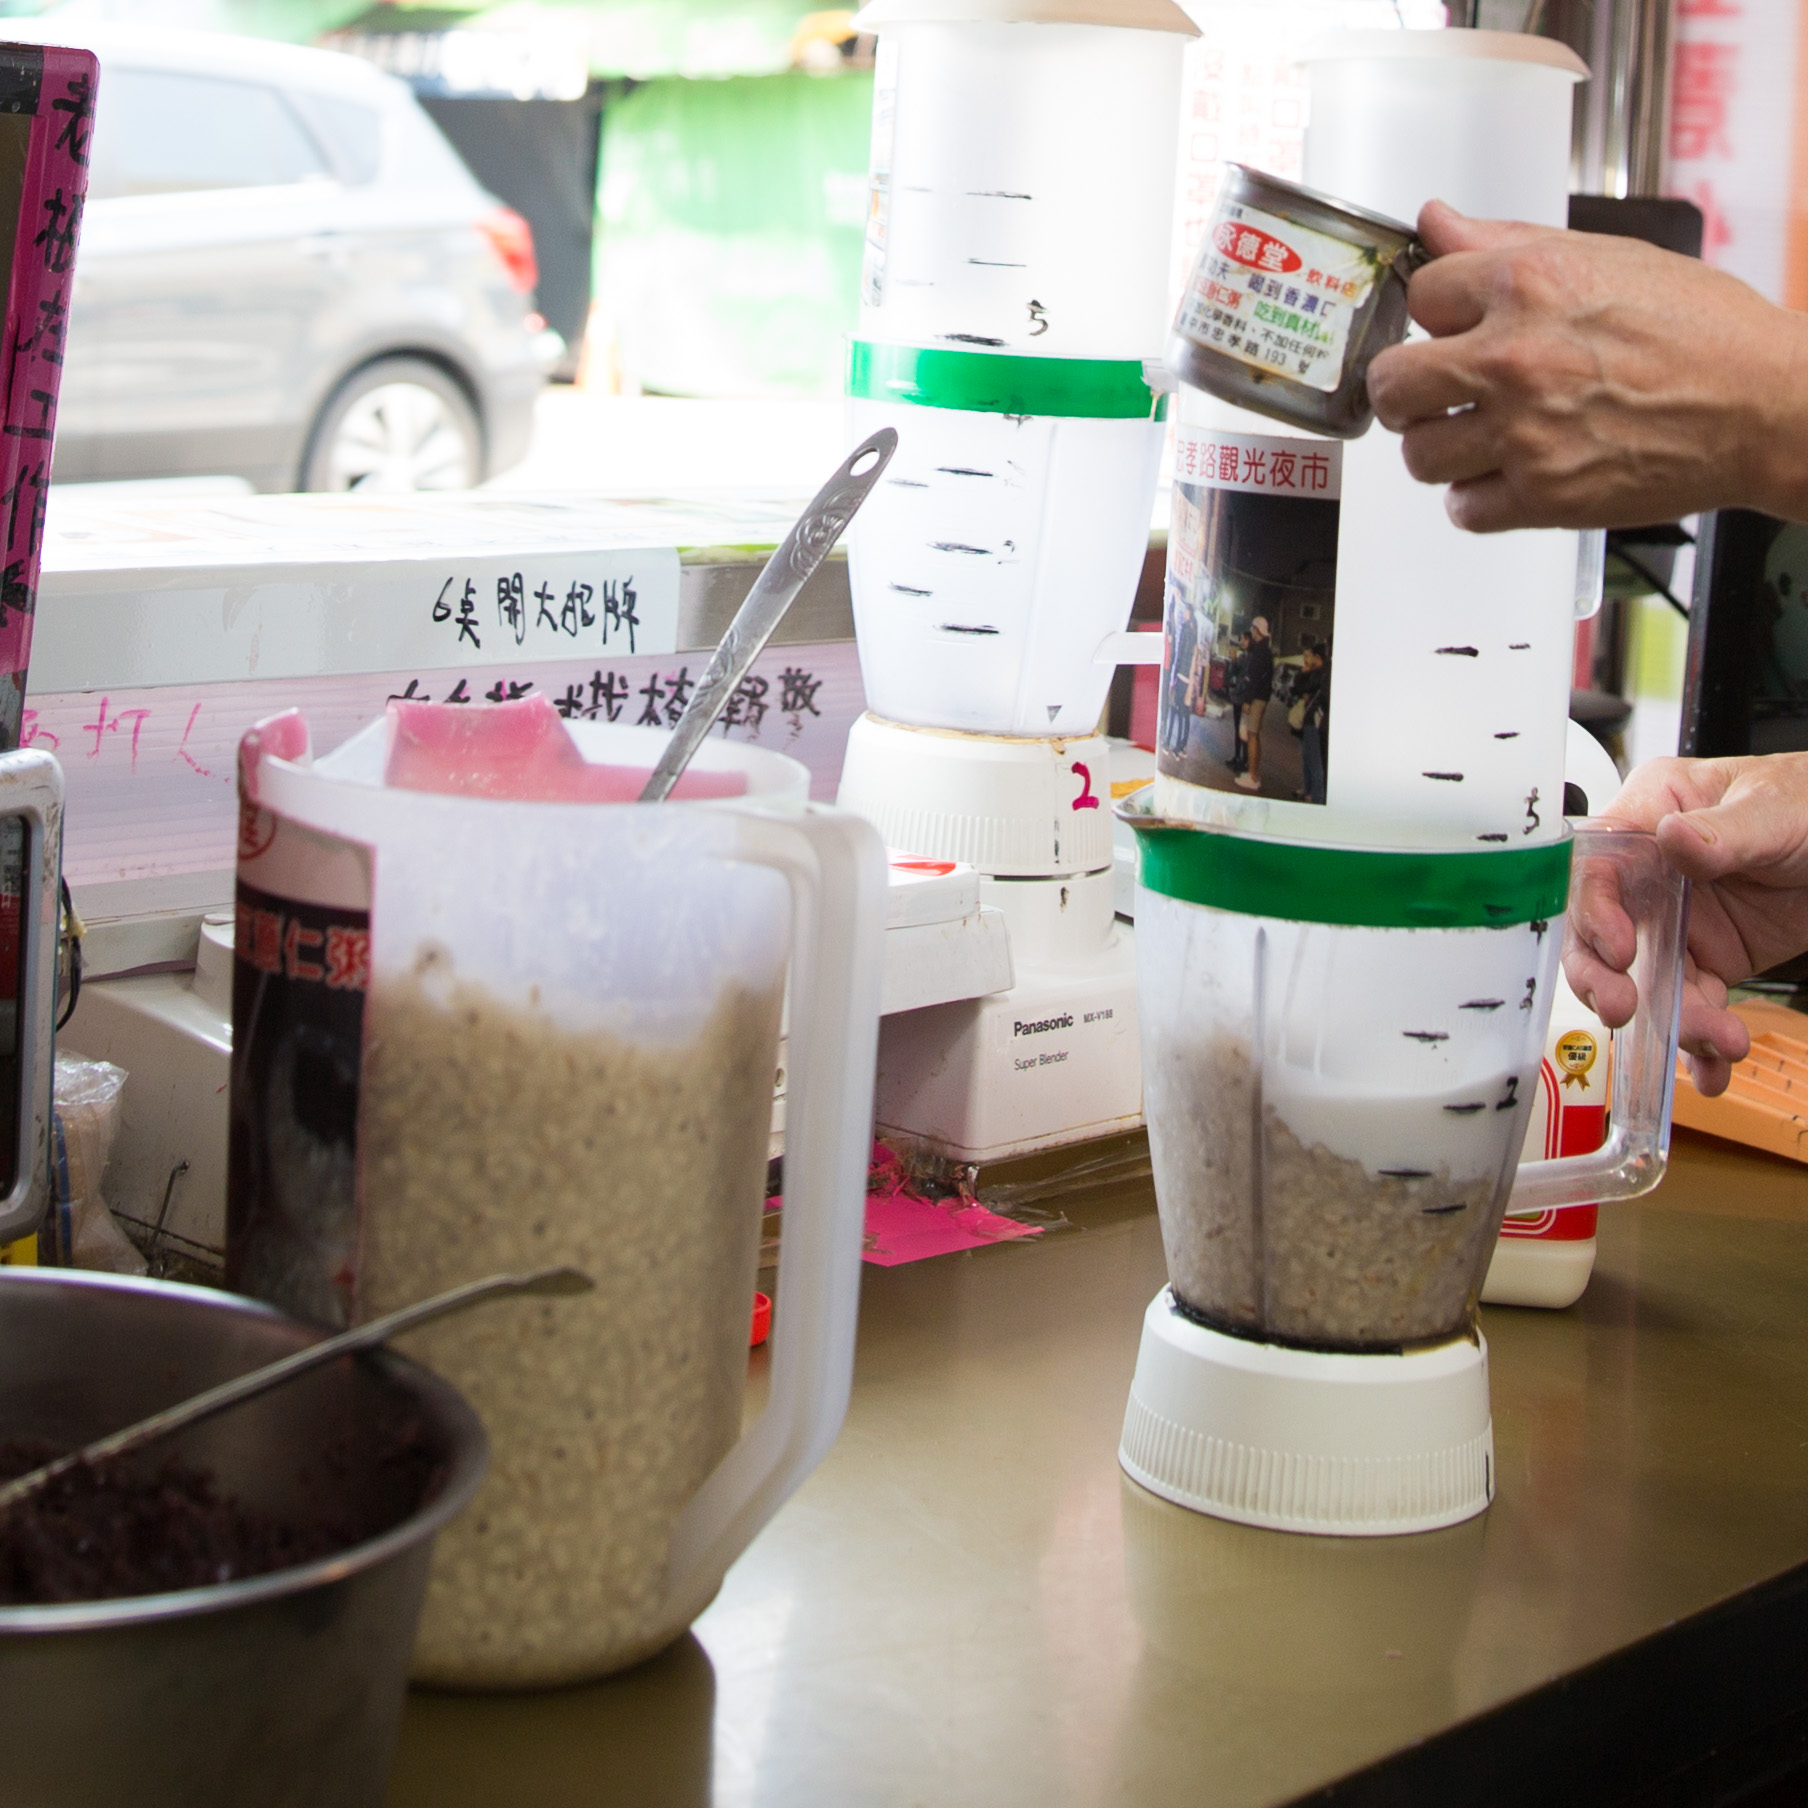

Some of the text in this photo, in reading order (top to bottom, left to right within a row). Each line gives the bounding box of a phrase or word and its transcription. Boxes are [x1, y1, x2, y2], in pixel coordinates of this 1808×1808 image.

[1025, 298, 1050, 337] 5
[1070, 760, 1100, 811] 2
[1521, 786, 1541, 836] 5
[1013, 1012, 1074, 1038] Panasonic
[1014, 1049, 1070, 1072] Super Blender
